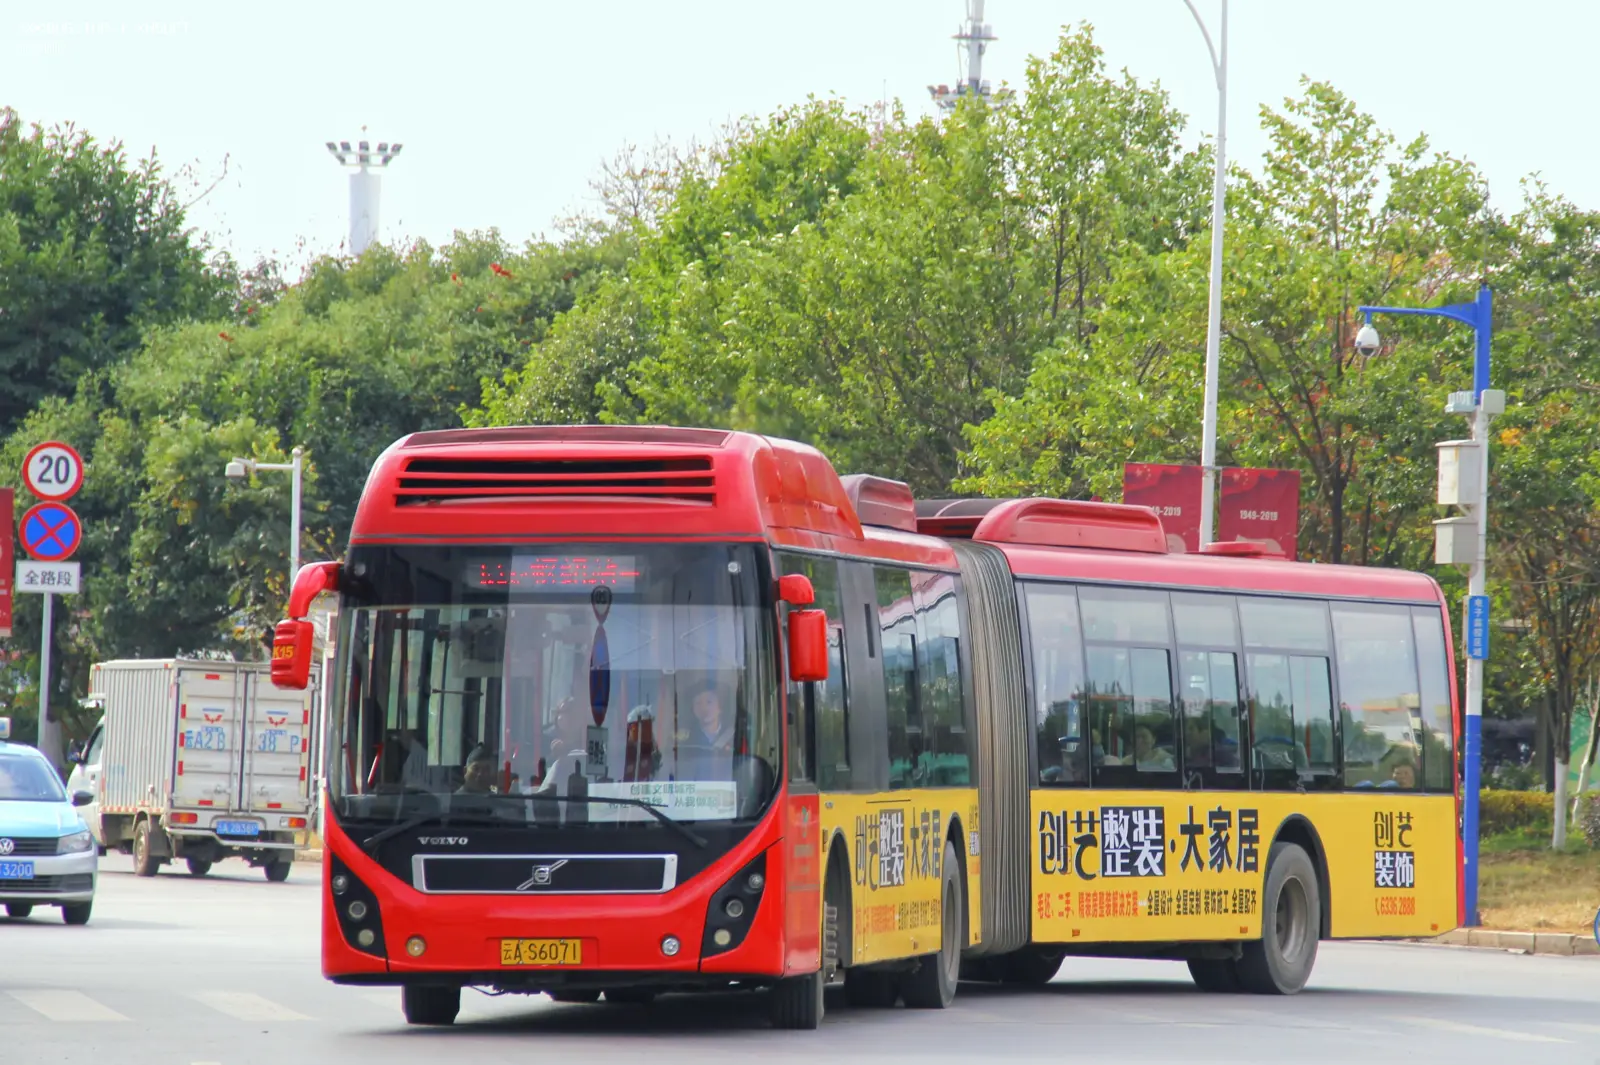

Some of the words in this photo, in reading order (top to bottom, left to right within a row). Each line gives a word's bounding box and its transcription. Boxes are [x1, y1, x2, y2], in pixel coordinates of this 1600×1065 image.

[38, 455, 70, 485] 20
[1240, 510, 1279, 521] 1949-2019
[25, 570, 72, 586] 全路段
[272, 645, 294, 659] K15
[1374, 811, 1414, 848] 创艺
[418, 836, 469, 846] VOLVO
[1375, 852, 1414, 887] 装饰
